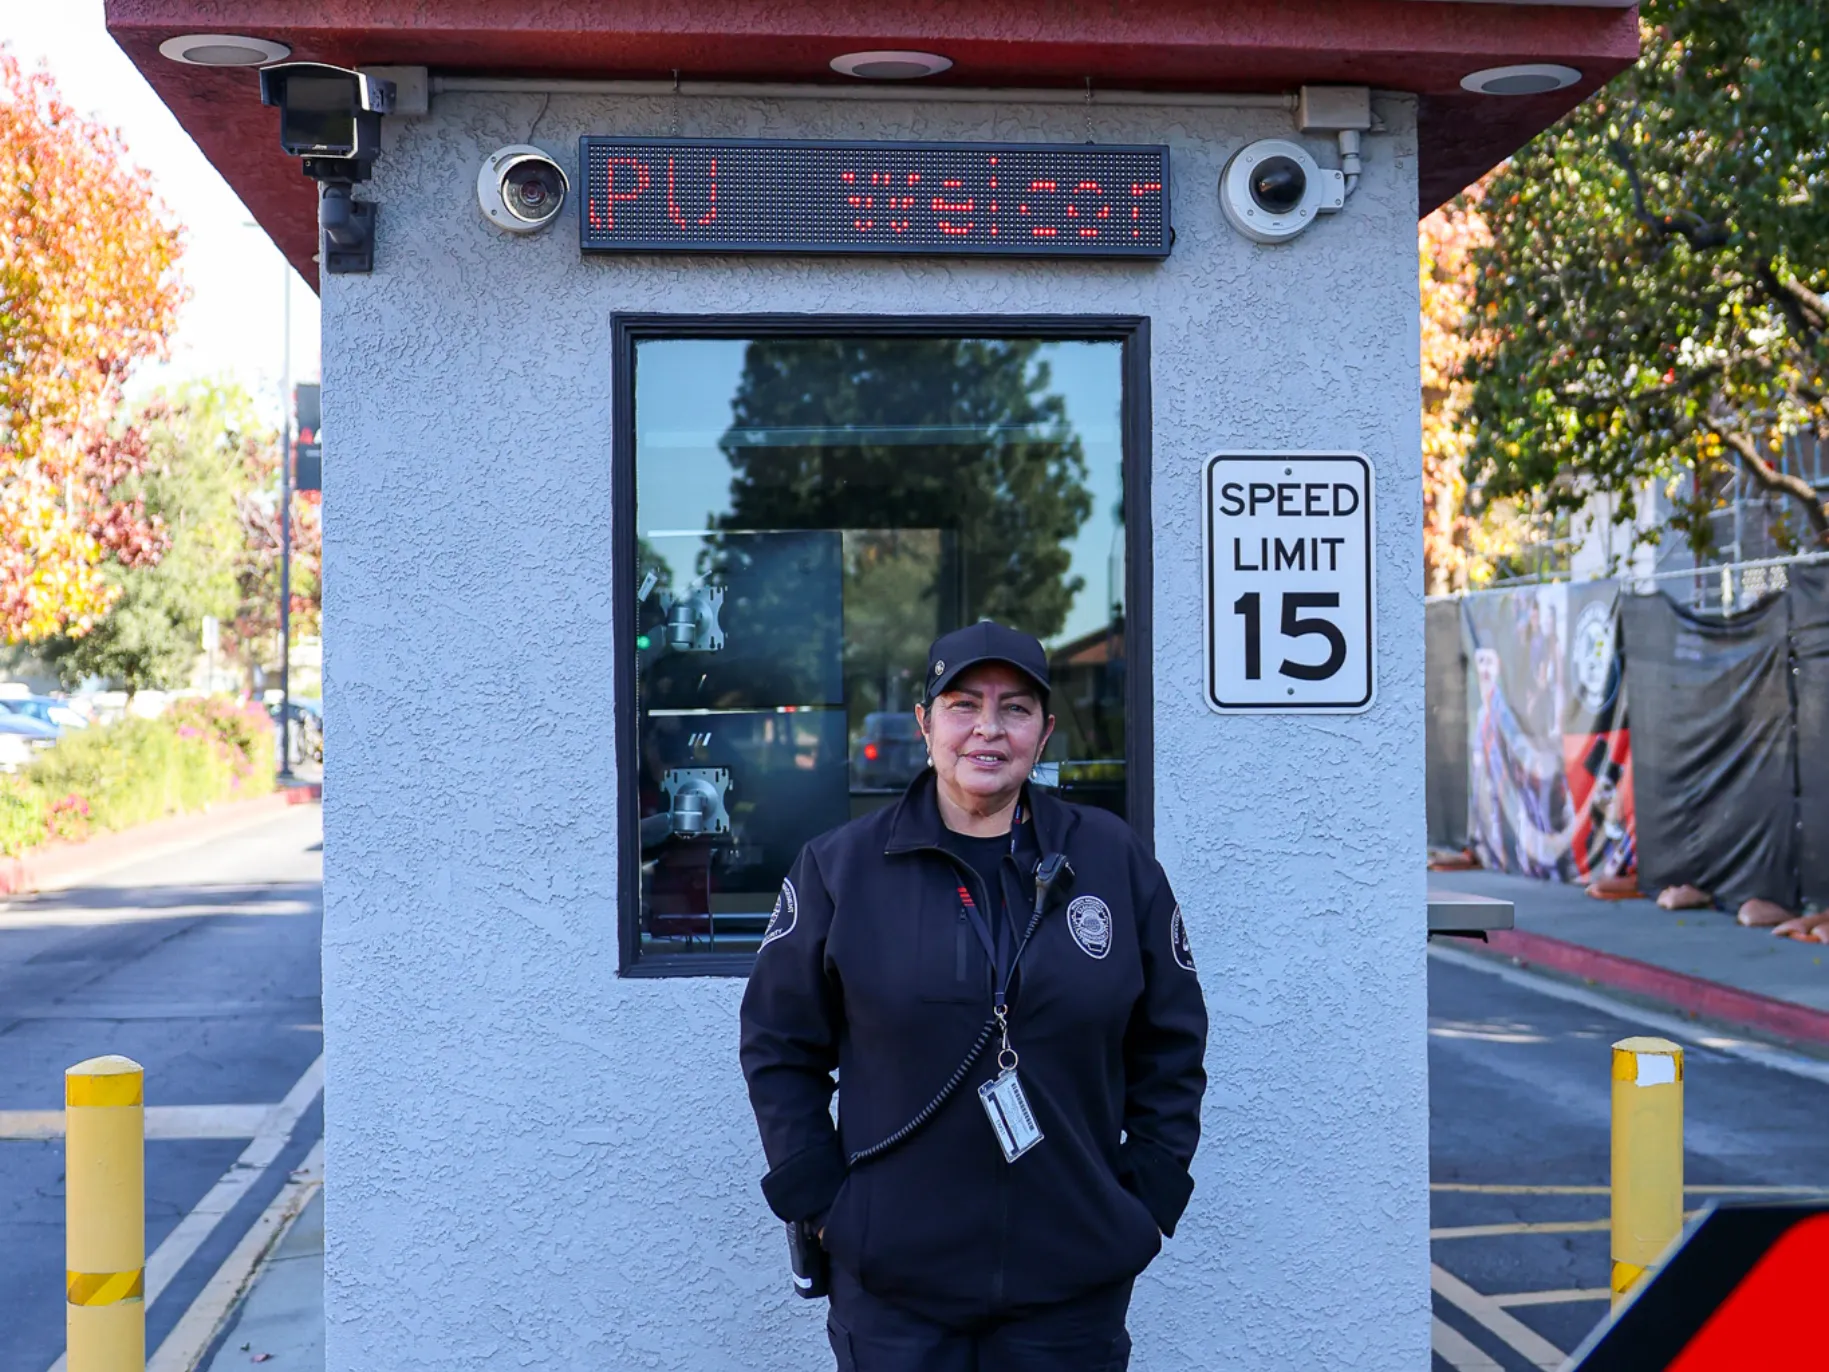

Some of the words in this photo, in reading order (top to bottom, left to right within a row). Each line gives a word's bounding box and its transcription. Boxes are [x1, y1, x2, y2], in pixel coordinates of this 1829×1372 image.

[1219, 482, 1360, 517] SPEED
[1234, 537, 1345, 571] LIMIT
[1233, 591, 1348, 681] 15
